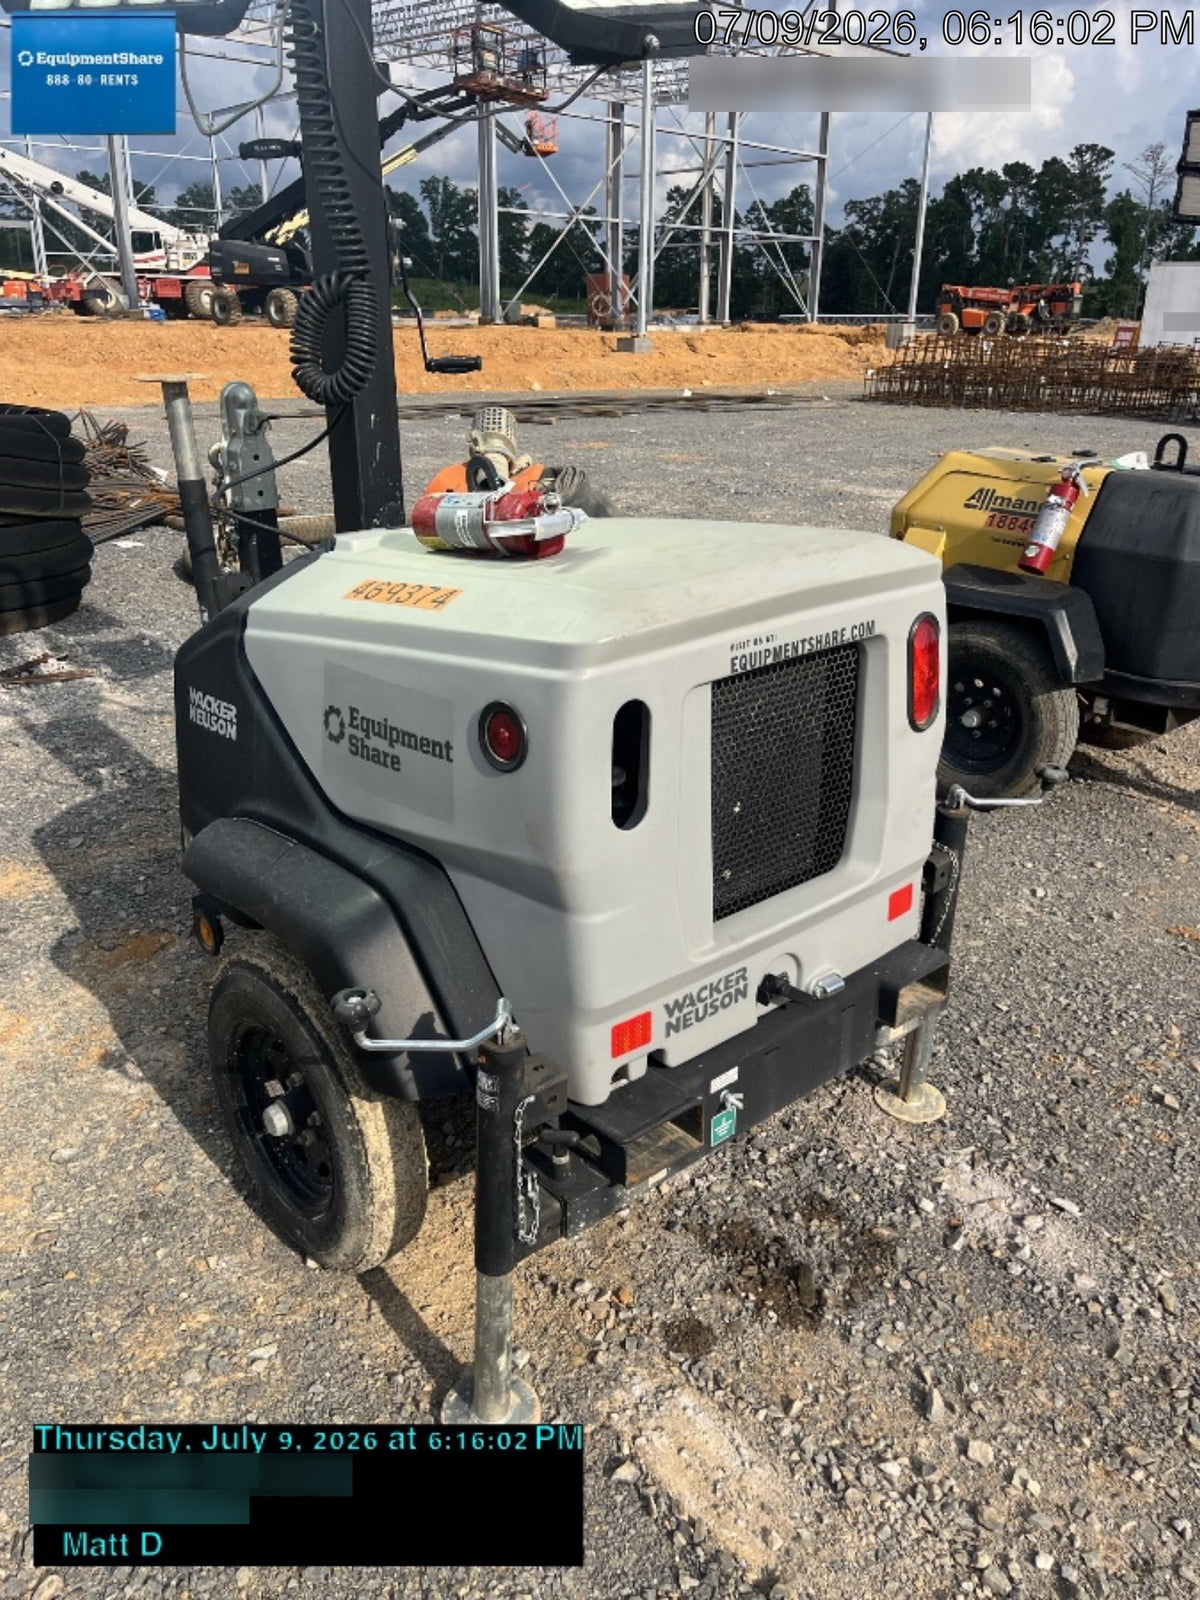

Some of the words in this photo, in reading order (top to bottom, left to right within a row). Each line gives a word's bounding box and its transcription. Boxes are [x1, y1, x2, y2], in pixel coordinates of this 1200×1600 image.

[963, 486, 1043, 513] Allman
[730, 620, 876, 674] EQUIPMENTSHARE.COM
[189, 686, 237, 724] WACKER
[189, 703, 237, 741] NEUSON
[348, 705, 454, 763] Equipment
[348, 733, 402, 772] Share
[663, 966, 748, 1018] WACKER
[665, 982, 748, 1039] NEUSON
